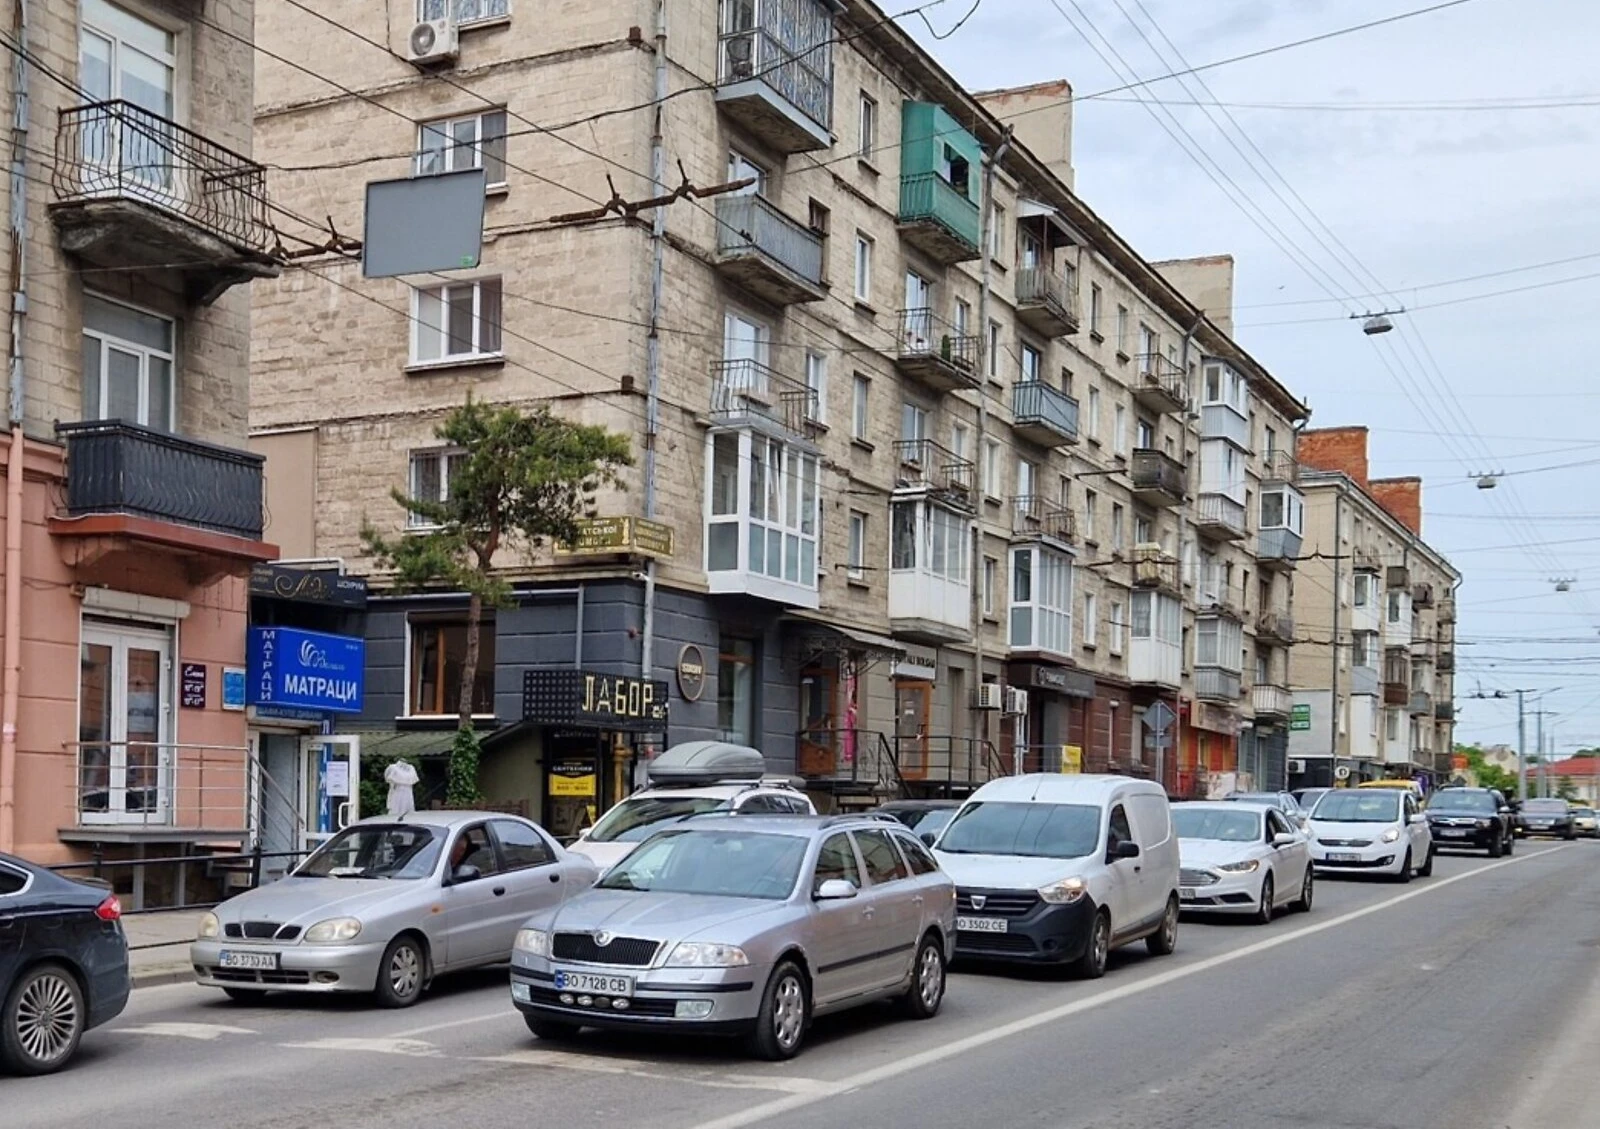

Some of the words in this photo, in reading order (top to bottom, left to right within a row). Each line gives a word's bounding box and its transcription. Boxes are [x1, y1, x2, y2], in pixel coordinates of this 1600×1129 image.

[261, 630, 275, 700] МАТРАЦИ
[284, 673, 357, 704] МАТРАЦИ
[563, 973, 579, 987] BO
[581, 975, 607, 990] 7128
[609, 978, 626, 992] CB
